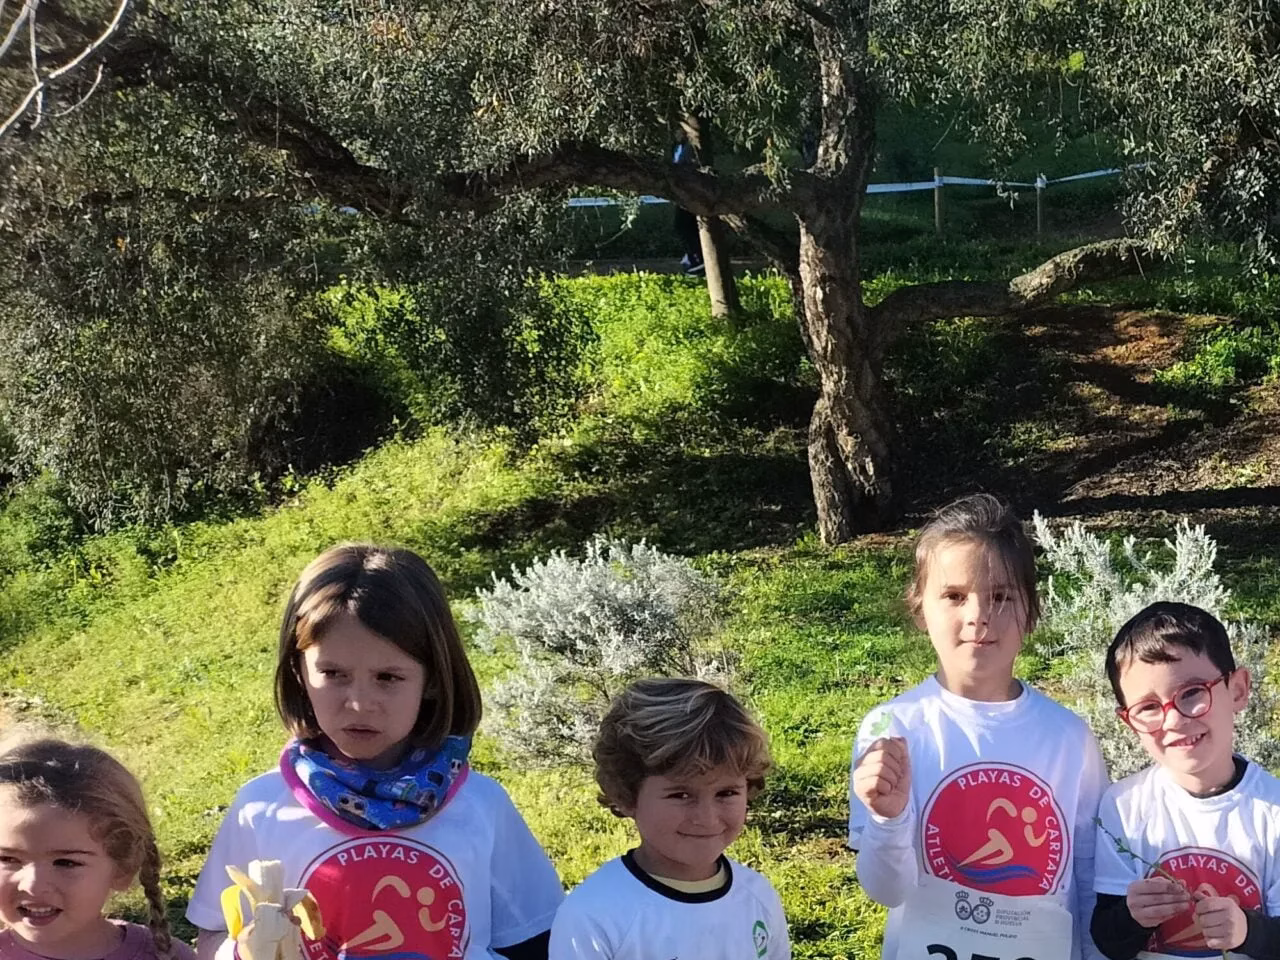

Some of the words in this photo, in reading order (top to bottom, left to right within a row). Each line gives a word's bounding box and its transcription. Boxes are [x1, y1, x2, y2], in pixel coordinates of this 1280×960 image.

[957, 771, 1021, 790] PLAYAS
[1029, 786, 1049, 808] DE
[1039, 816, 1061, 890] CARTAYA
[337, 844, 419, 866] PLAYAS
[428, 864, 454, 889] DE
[1169, 855, 1228, 874] PLAYAS
[1234, 874, 1256, 896] DE
